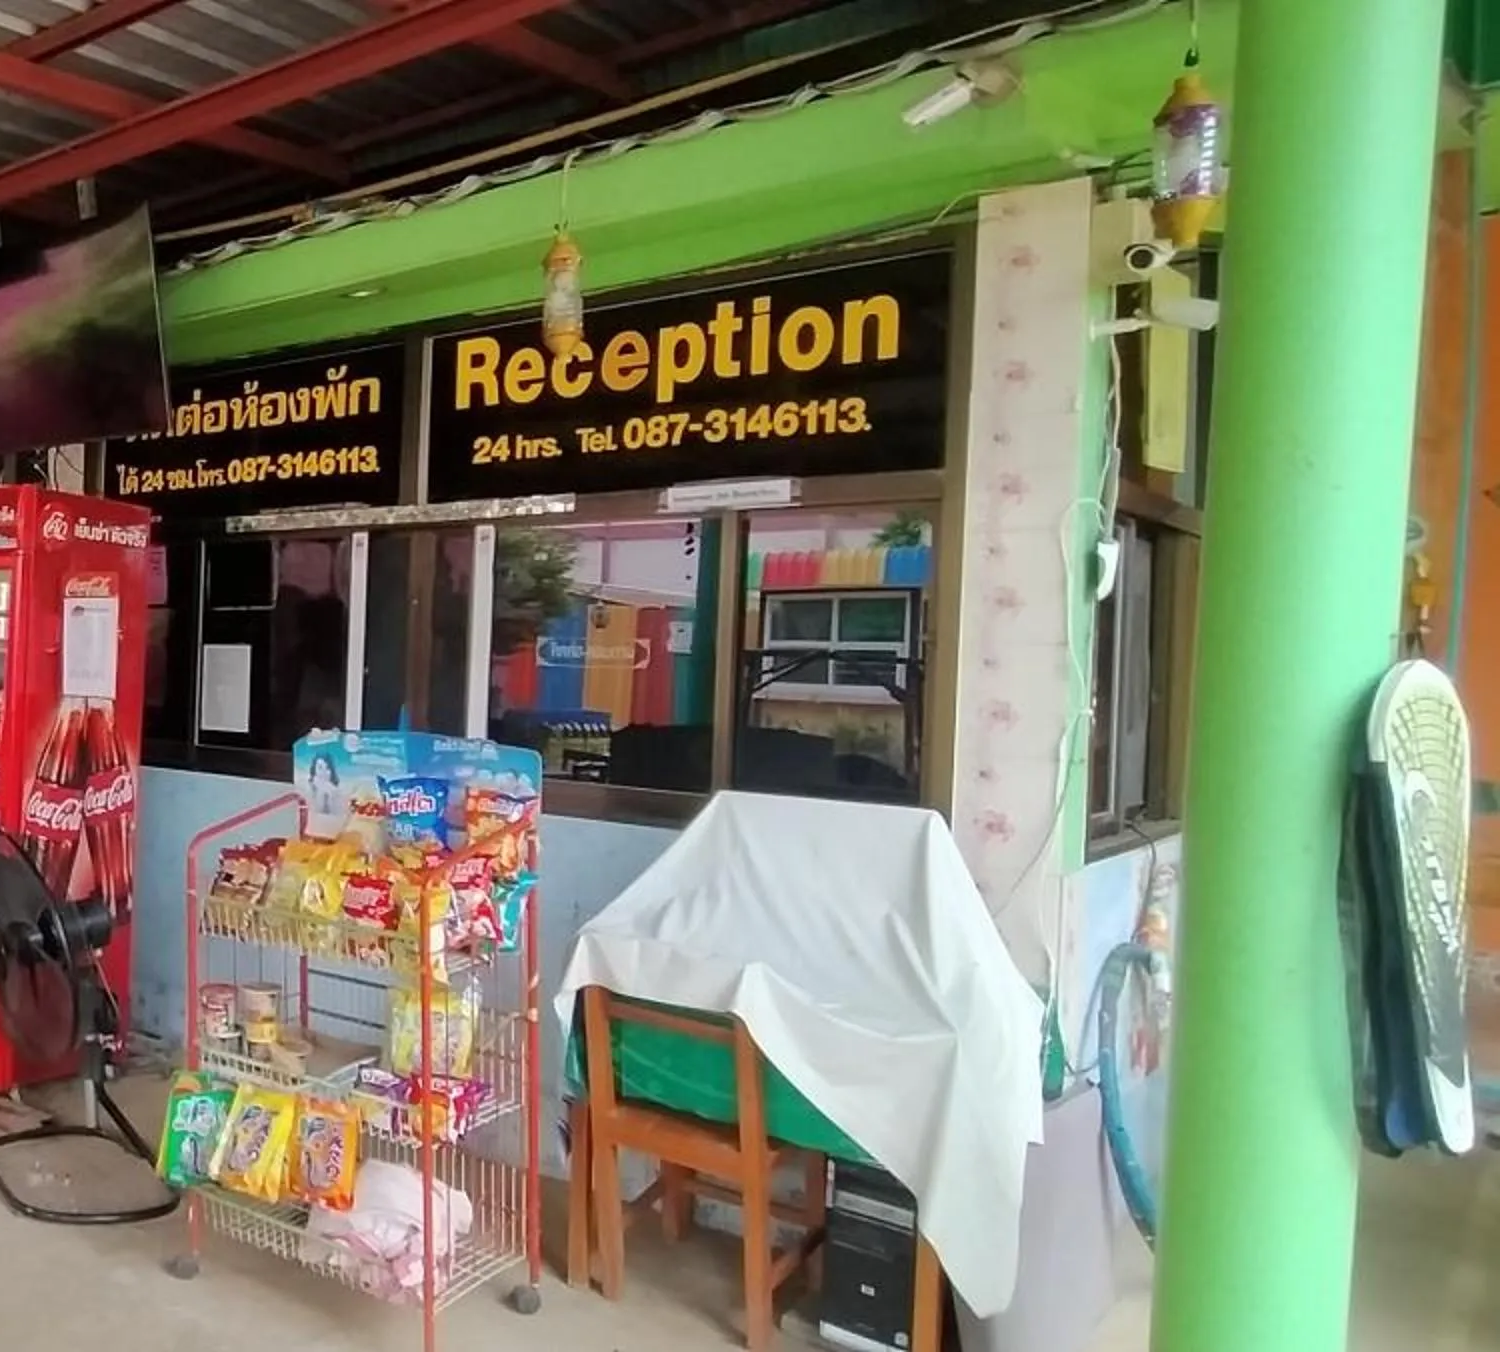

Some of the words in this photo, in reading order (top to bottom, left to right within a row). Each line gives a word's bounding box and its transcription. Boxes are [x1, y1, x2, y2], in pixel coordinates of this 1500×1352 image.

[455, 295, 899, 410] Reception
[125, 365, 381, 442] ต่อห้องพัก
[472, 434, 510, 464] 24
[515, 433, 562, 460] hrs.
[116, 464, 139, 495] ได้
[141, 469, 165, 493] 24
